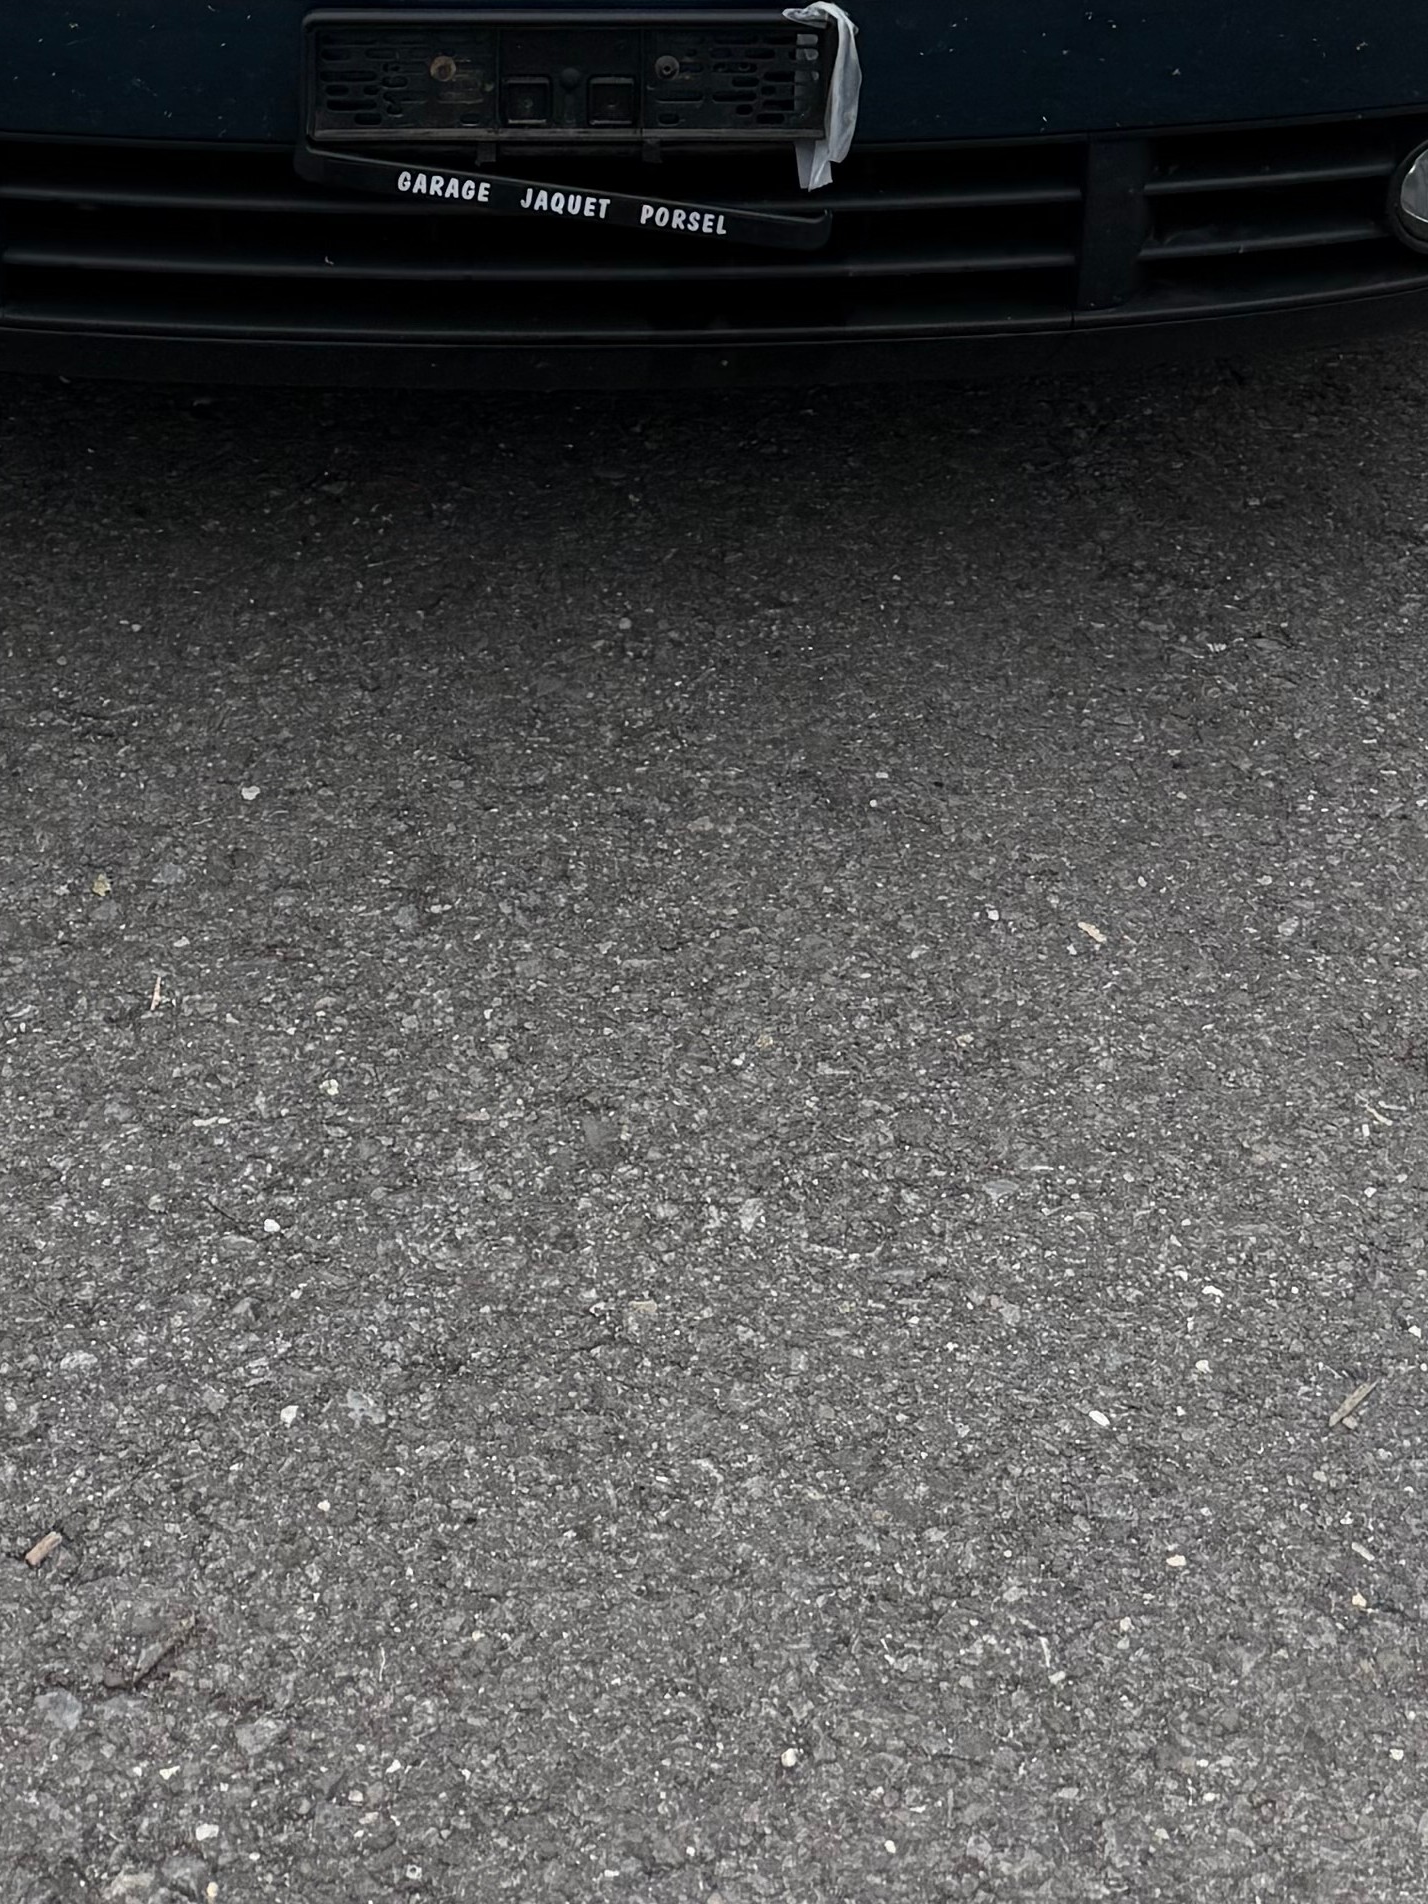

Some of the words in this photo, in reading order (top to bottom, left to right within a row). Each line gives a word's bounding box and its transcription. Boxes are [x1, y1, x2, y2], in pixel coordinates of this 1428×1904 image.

[397, 170, 491, 203] GARAGE
[520, 188, 611, 219] JAQUET
[640, 204, 727, 235] PORSEL
